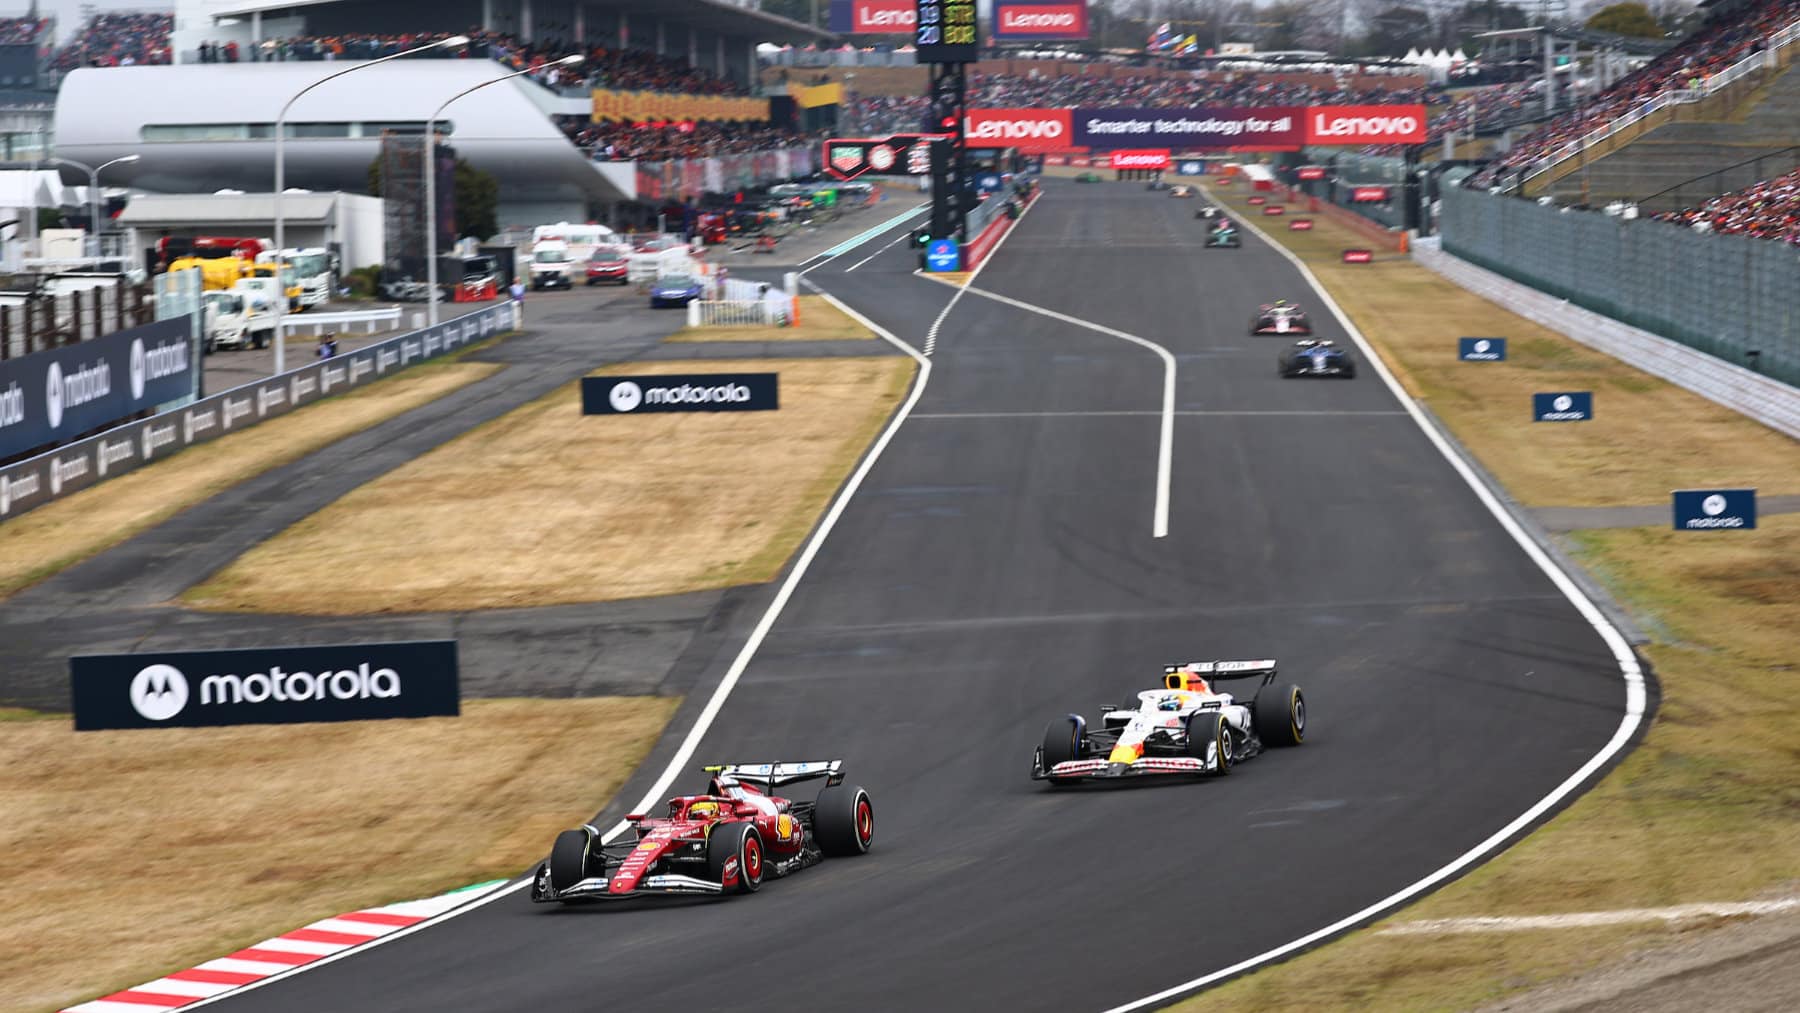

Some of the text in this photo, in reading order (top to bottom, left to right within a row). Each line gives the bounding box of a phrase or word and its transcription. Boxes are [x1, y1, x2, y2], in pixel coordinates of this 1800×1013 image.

[860, 7, 917, 26] Leno
[919, 5, 940, 24] 19
[1004, 11, 1075, 27] Lenovo
[918, 25, 940, 44] 20
[964, 116, 1064, 138] Lenovo
[1087, 116, 1292, 136] Smarter technology for all
[1315, 113, 1418, 136] Lenovo
[1113, 153, 1167, 166] Lenovo
[645, 382, 751, 405] motorola
[200, 661, 401, 705] motorola
